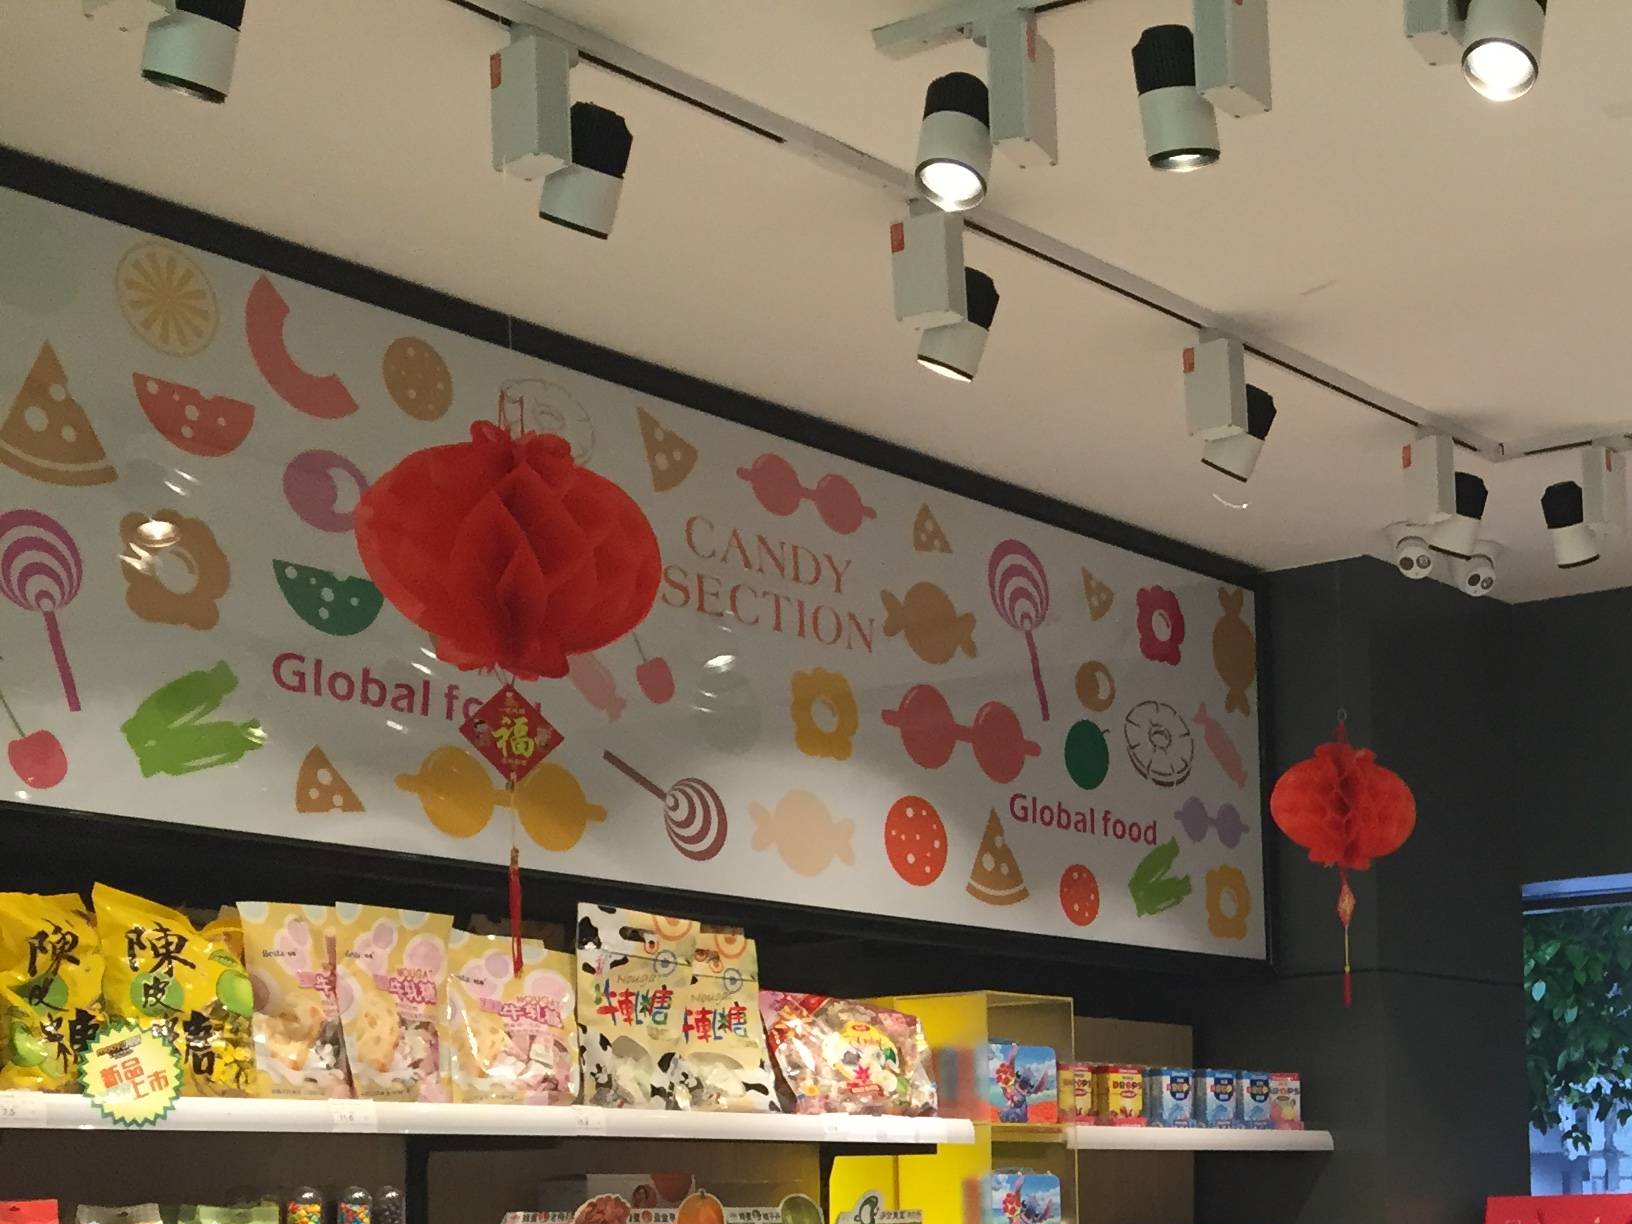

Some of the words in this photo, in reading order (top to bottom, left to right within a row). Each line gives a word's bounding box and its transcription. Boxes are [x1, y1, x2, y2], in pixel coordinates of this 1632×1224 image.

[685, 516, 853, 594] CANDY
[662, 564, 875, 653] SECTION
[272, 652, 430, 717] Global
[493, 715, 535, 758] 福
[1009, 793, 1095, 835] Global
[1102, 812, 1158, 846] food
[100, 1057, 144, 1090] 新品
[132, 1069, 170, 1100] 上市
